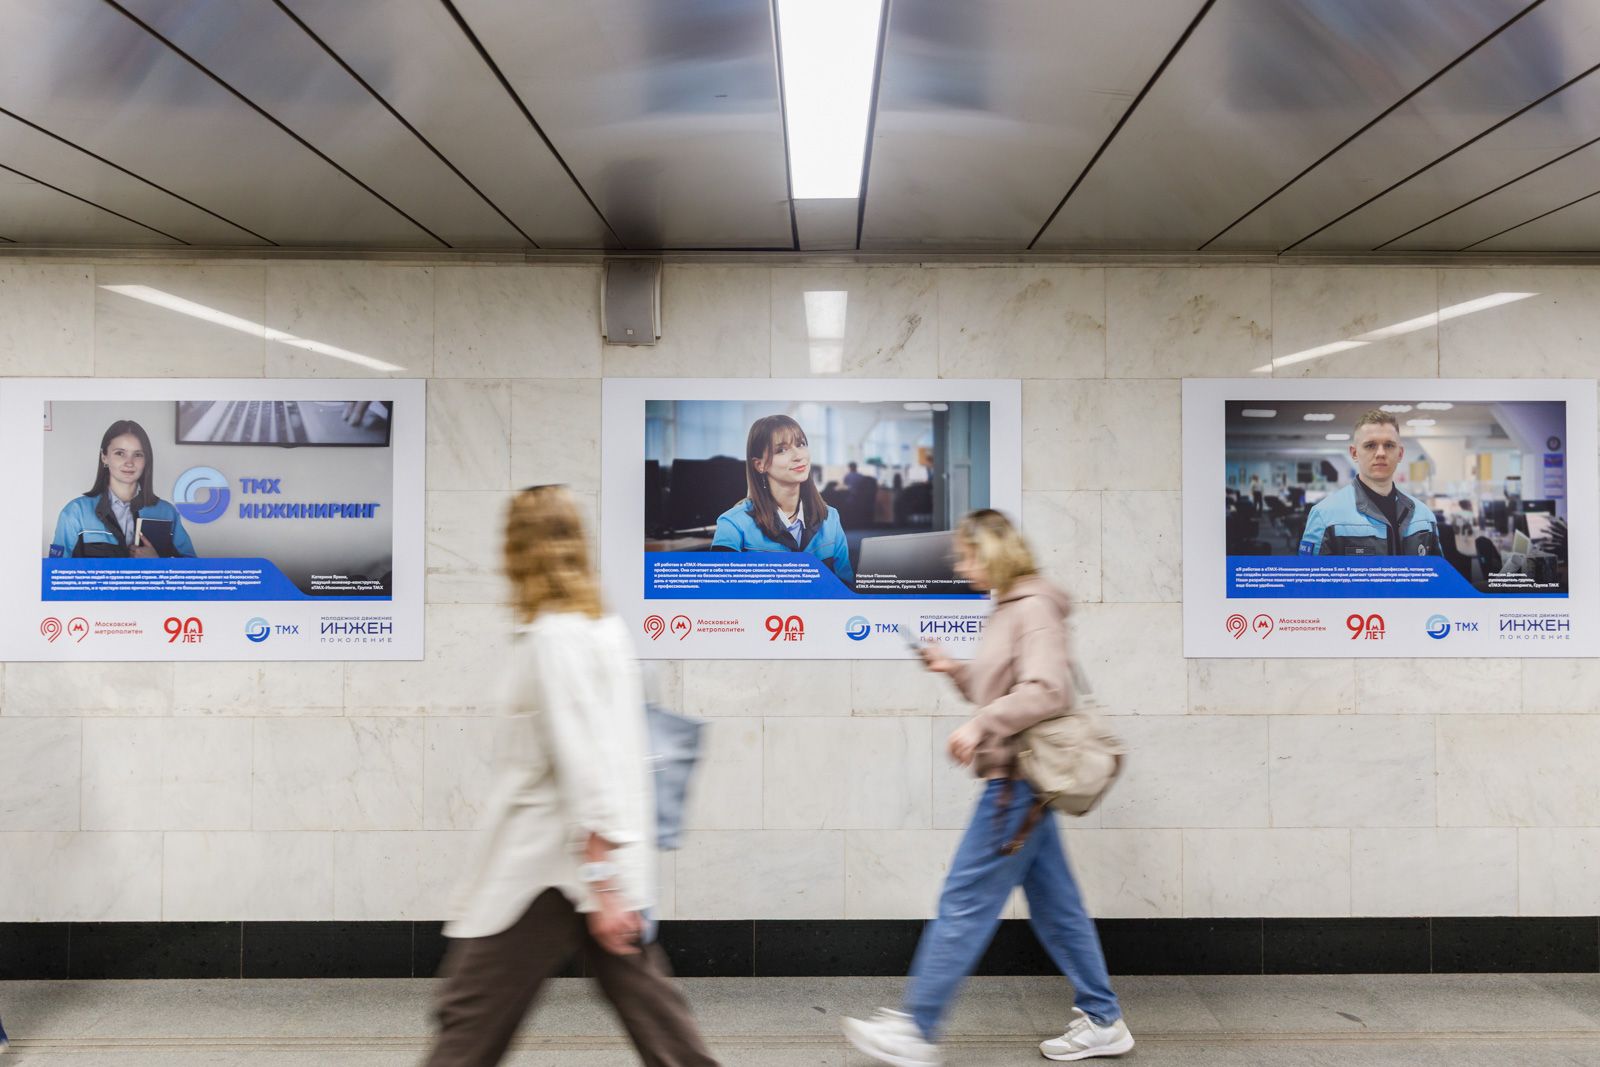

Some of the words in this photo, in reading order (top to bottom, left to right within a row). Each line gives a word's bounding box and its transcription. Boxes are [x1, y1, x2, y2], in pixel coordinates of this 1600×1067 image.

[240, 478, 280, 494] ТМХ
[240, 503, 380, 518] ИНЖИНИРИНГ
[275, 625, 299, 634] ТМХ
[321, 622, 392, 634] ИНЖЕН
[875, 624, 898, 632] ТМХ
[1455, 622, 1478, 631] ТМХ
[1500, 619, 1570, 631] ИНЖЕН
[182, 635, 203, 643] ЛЕТ
[784, 633, 805, 641] ЛЕТ
[1365, 631, 1386, 640] ЛЕТ
